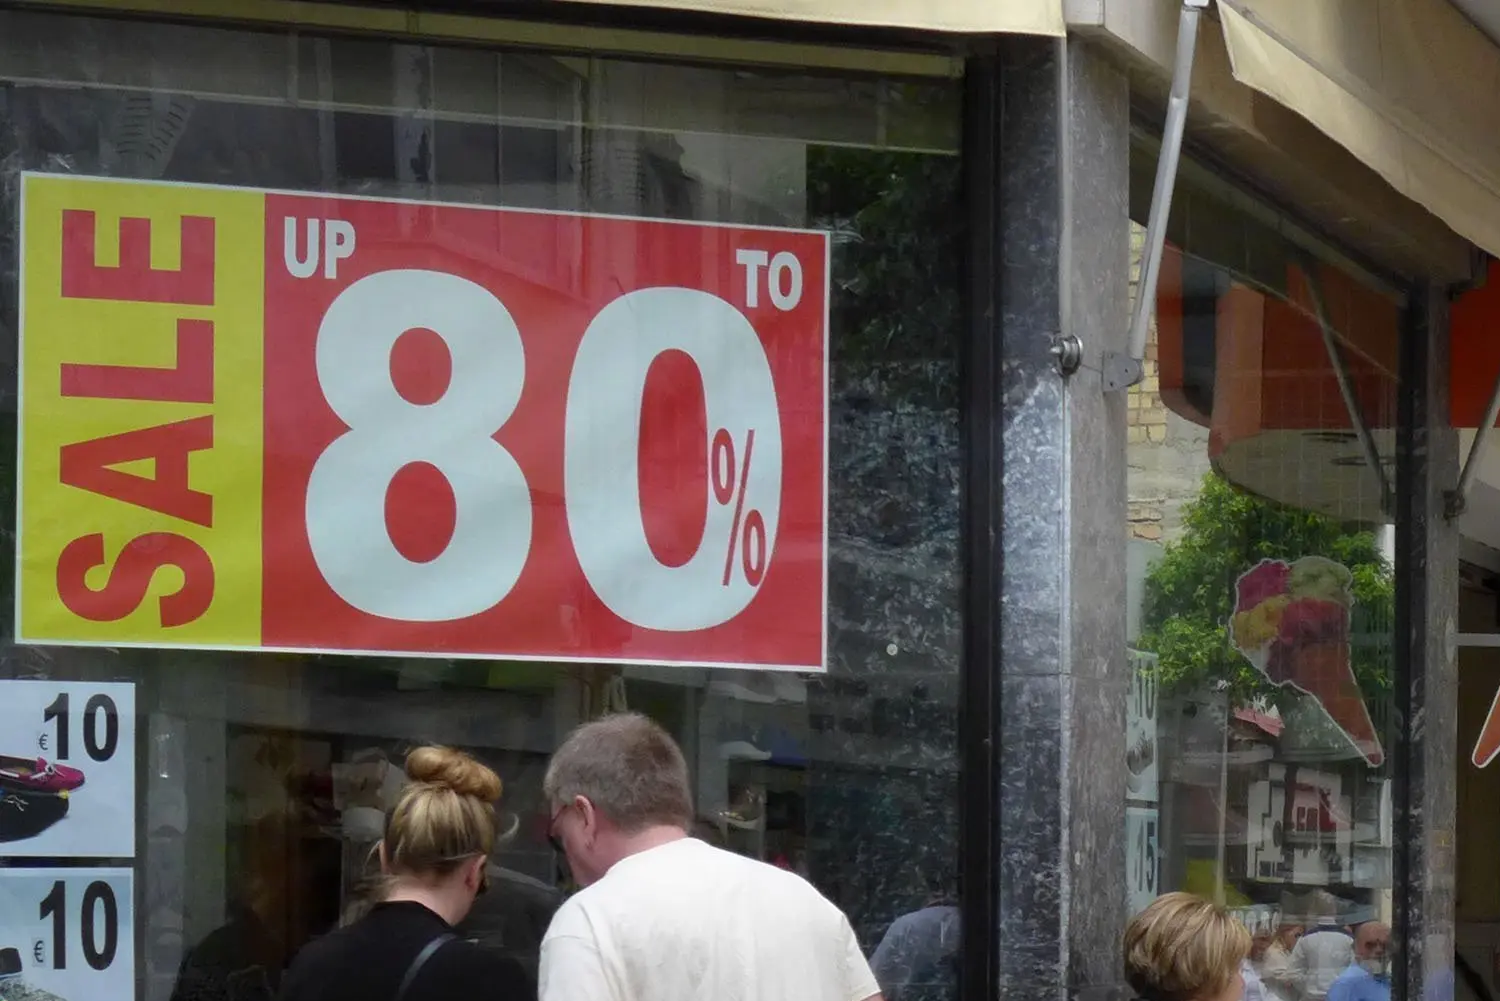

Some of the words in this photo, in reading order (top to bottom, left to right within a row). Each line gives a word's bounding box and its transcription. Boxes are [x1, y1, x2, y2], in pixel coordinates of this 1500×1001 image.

[283, 217, 356, 280] UP
[736, 248, 803, 312] TO
[56, 209, 215, 628] SALE
